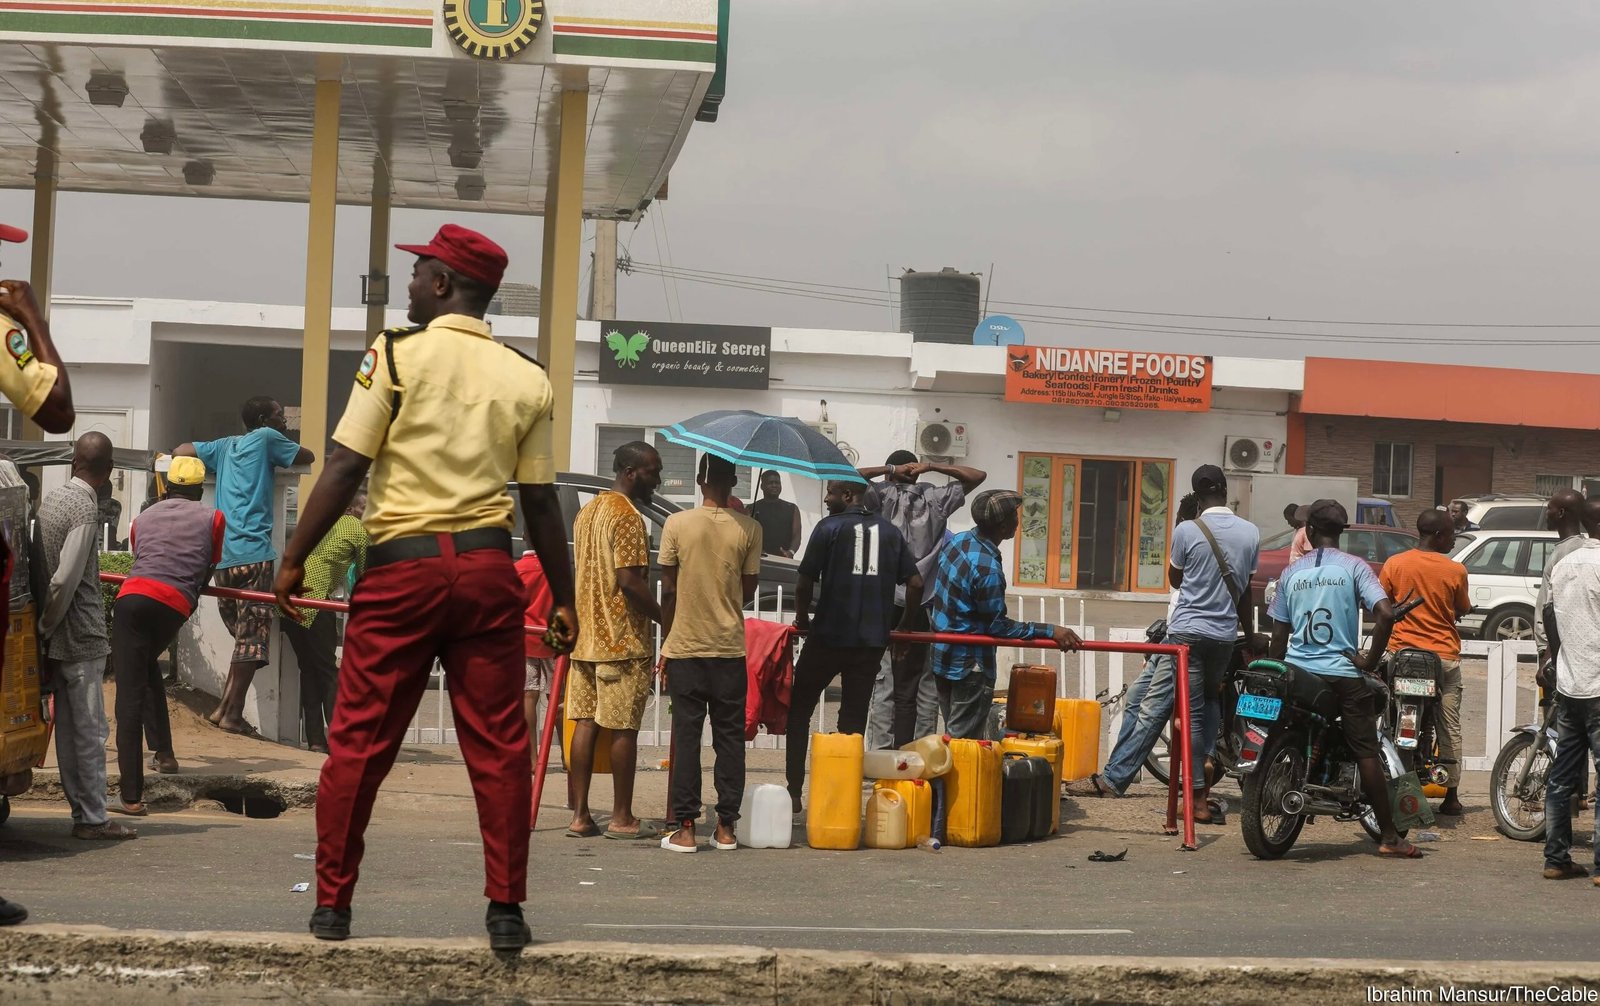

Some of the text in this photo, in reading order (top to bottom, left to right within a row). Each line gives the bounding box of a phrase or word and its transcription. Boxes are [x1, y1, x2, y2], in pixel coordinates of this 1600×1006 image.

[652, 339, 766, 357] QueenEliz Secret
[1035, 347, 1206, 379] NIDANRE FOODS
[651, 360, 765, 375] organic beauty & cosmetics
[851, 522, 880, 576] 11
[1303, 607, 1334, 646] 16
